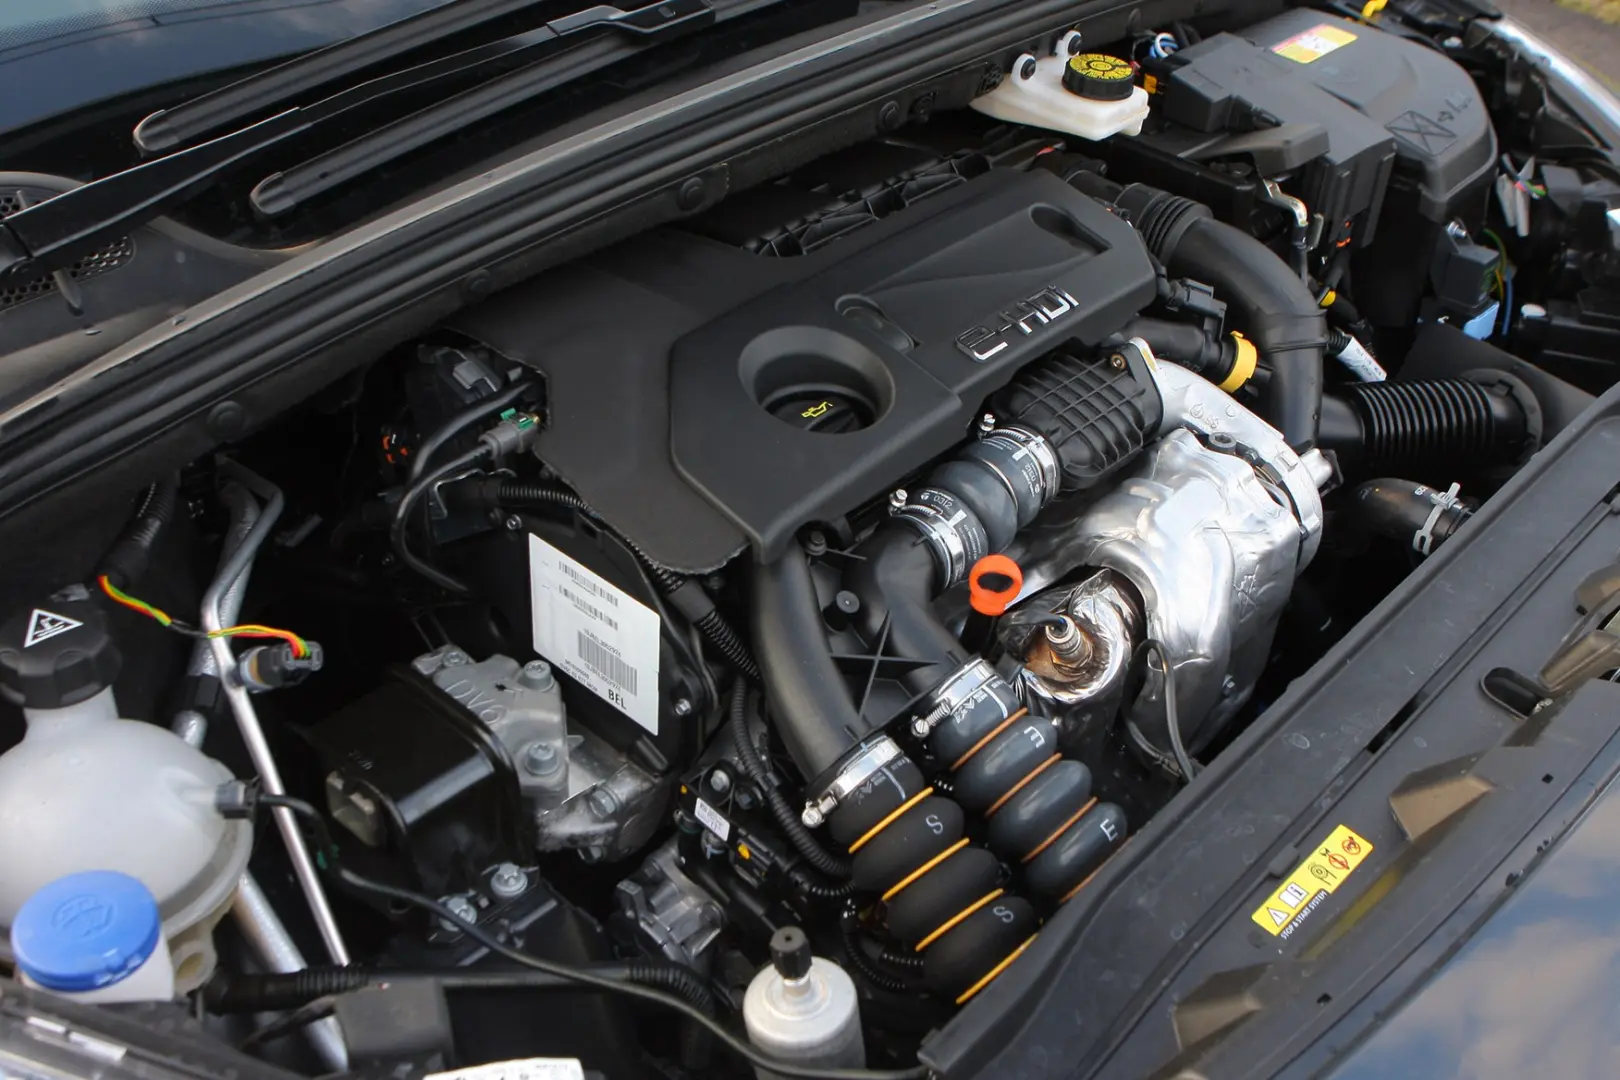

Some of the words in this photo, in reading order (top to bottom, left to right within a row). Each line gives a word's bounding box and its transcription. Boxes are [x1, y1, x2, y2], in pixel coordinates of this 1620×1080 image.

[608, 687, 627, 710] BEL
[925, 814, 944, 835] S
[1099, 818, 1119, 842] E
[993, 905, 1015, 923] S
[1280, 923, 1295, 940] STOP
[1295, 906, 1312, 924] START
[1307, 889, 1328, 910] SYSTEM
